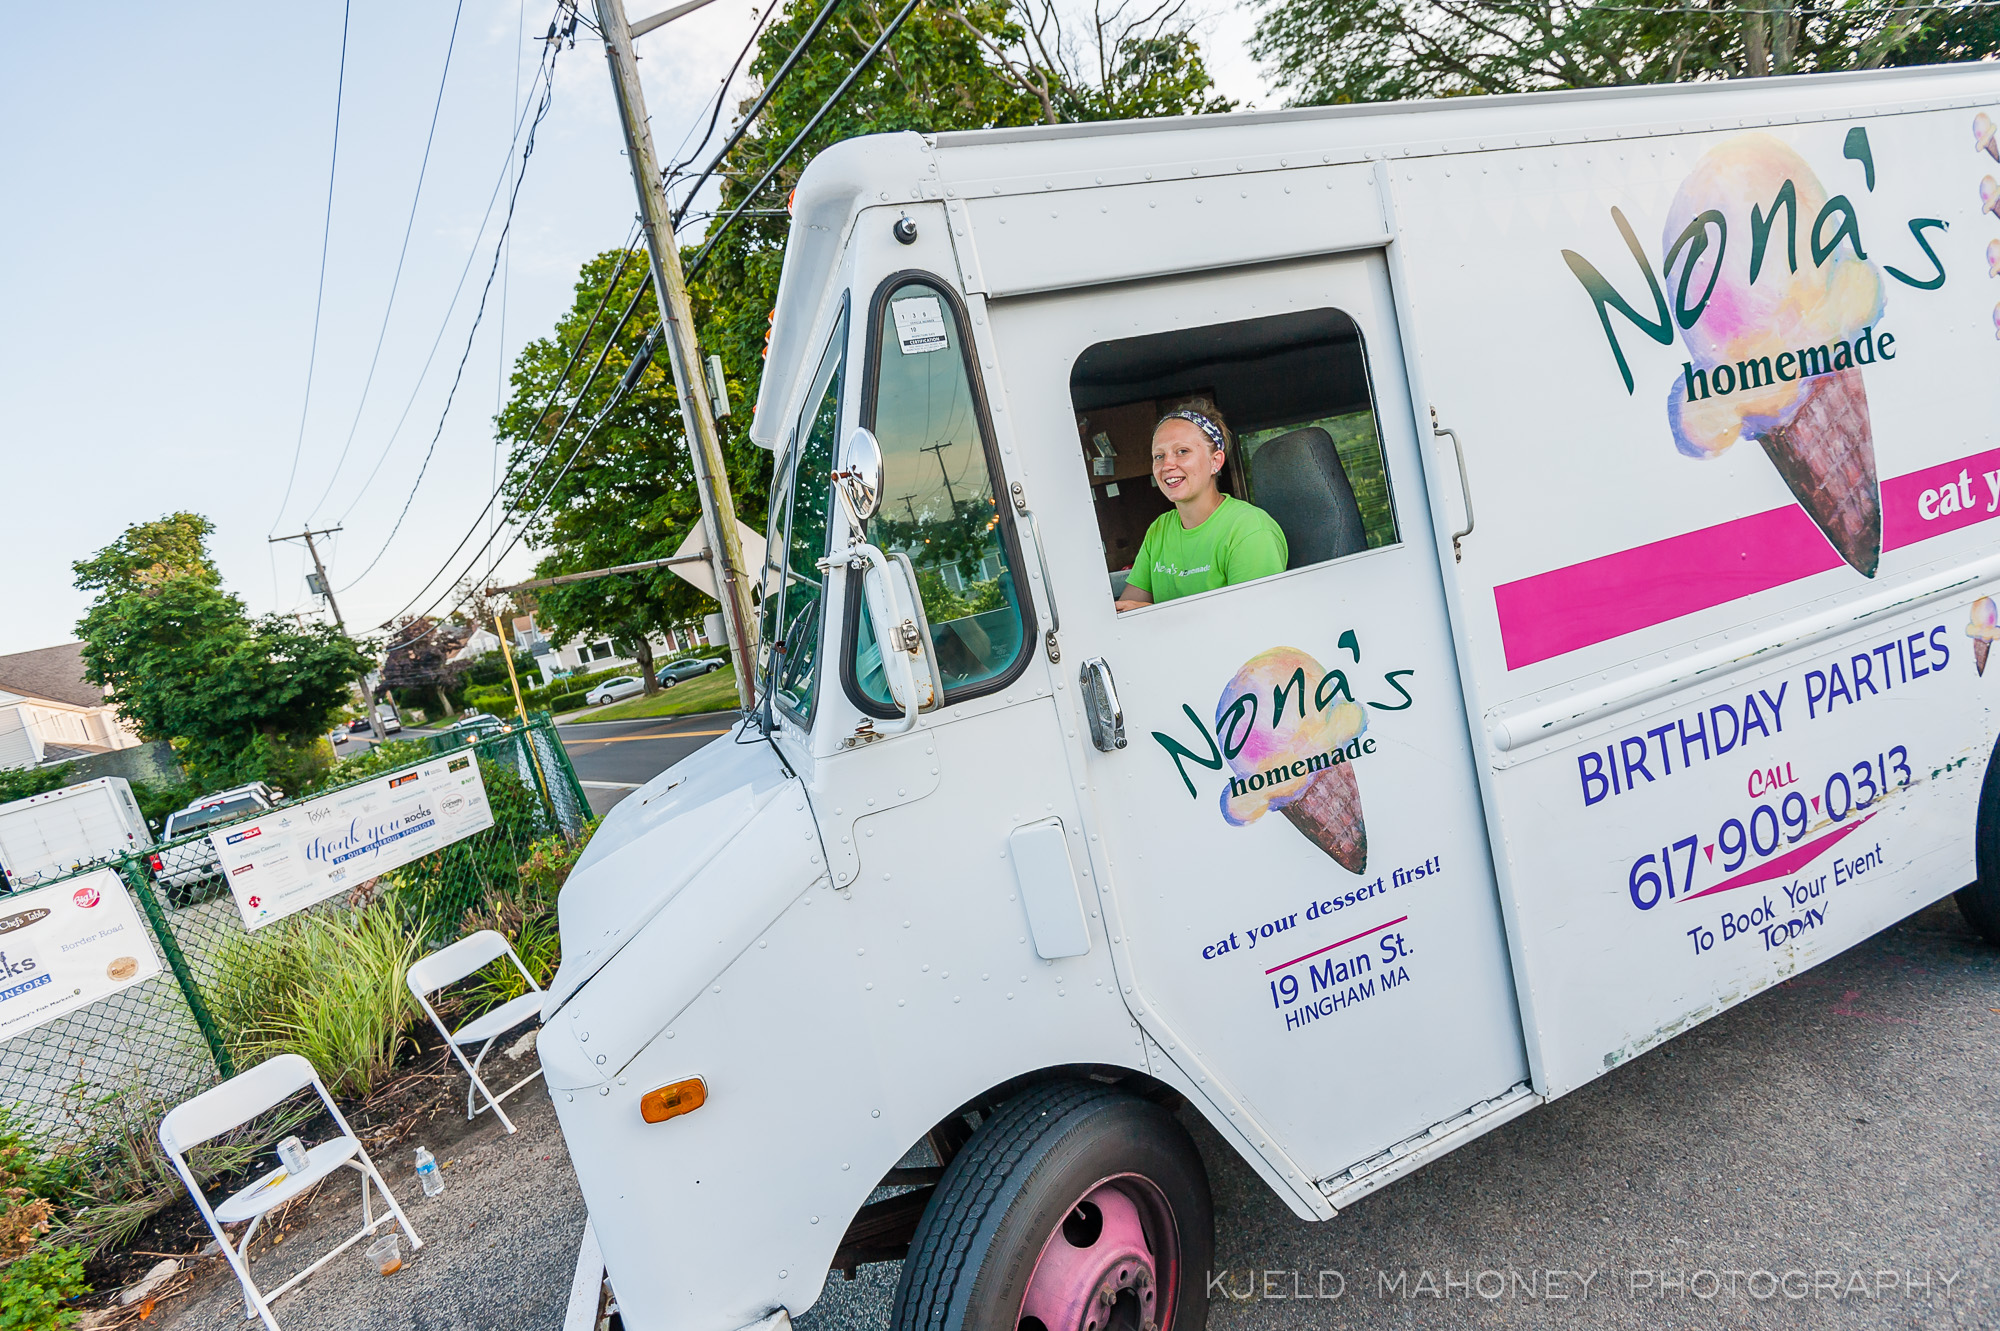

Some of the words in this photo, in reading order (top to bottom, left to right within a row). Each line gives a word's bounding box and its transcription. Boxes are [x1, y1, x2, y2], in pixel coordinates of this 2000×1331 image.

[1561, 127, 1950, 396] Nona's
[1682, 326, 1896, 402] homemade
[1918, 468, 1976, 520] eat
[1153, 561, 1178, 575] Noa's
[1151, 629, 1414, 800] Nona's
[1577, 681, 1789, 807] BIRTHDAY
[1804, 625, 1950, 719] PARTIES
[1229, 736, 1377, 798] homemade
[1748, 762, 1799, 799] CALL
[307, 816, 363, 862] thank
[368, 820, 400, 859] you
[336, 854, 346, 863] TO
[348, 848, 364, 859] OUR
[365, 834, 401, 852] GENEROUS
[402, 820, 435, 836] SPONSORS
[24, 910, 47, 922] Table
[1202, 932, 1240, 960] eat
[1246, 912, 1298, 949] your
[1306, 876, 1387, 921] dessert
[1392, 856, 1441, 888] first!
[1687, 926, 1714, 955] To
[1720, 895, 1776, 942] Book
[1782, 874, 1827, 909] Your
[1833, 842, 1884, 886] Event
[1758, 900, 1829, 952] TODAY
[60, 934, 97, 953] Border
[98, 923, 125, 939] Road
[1270, 974, 1300, 1009] 19
[1309, 953, 1372, 993] Main
[1380, 933, 1414, 964] St.
[1285, 979, 1376, 1032] HINGHAM
[1380, 966, 1411, 991] MA
